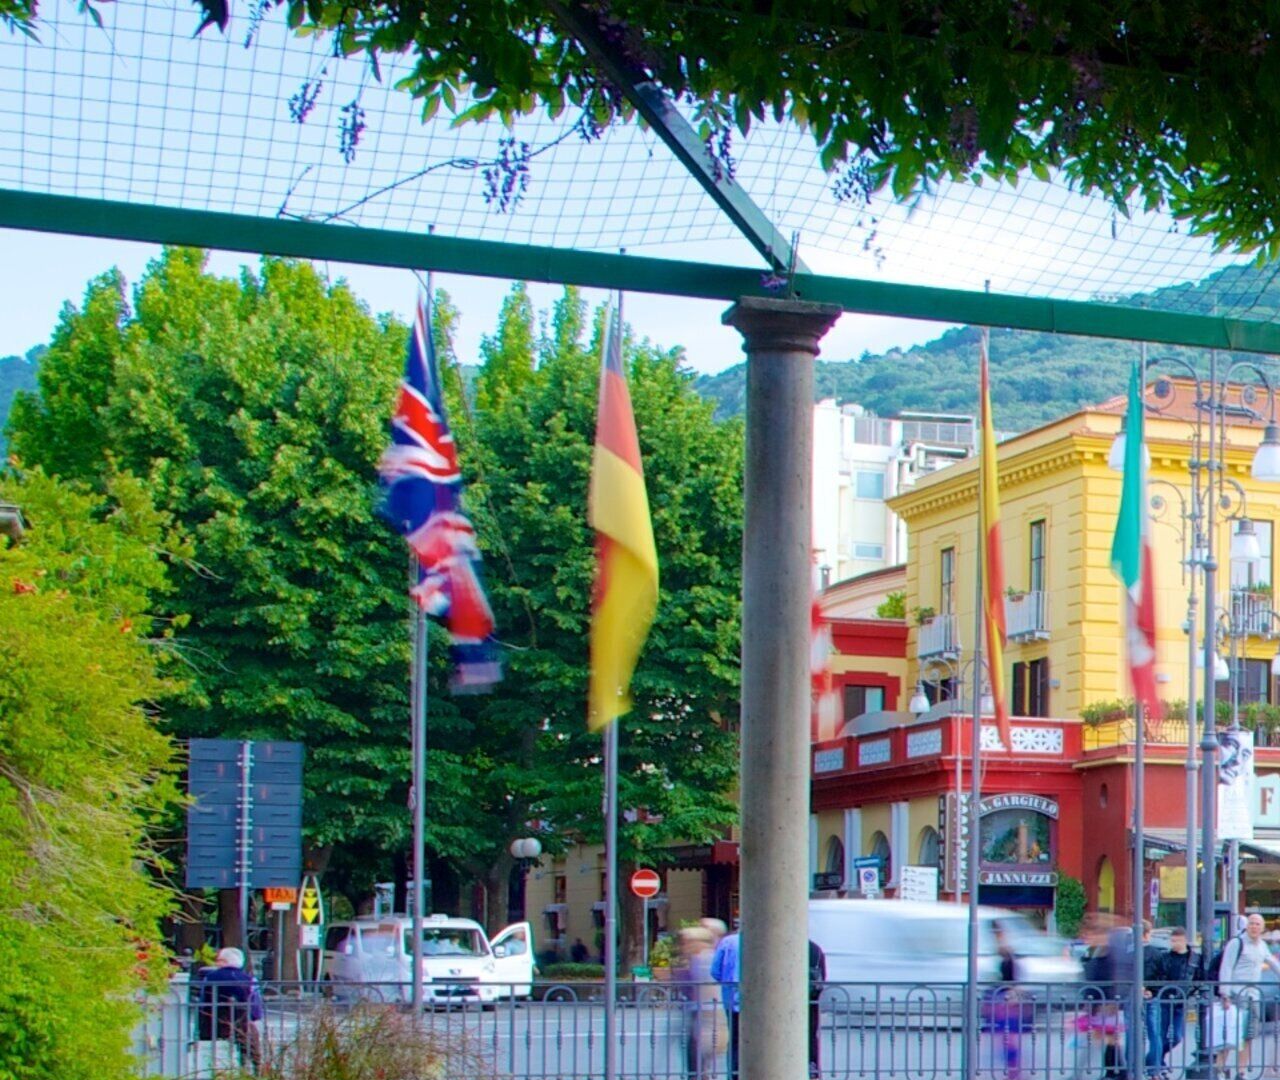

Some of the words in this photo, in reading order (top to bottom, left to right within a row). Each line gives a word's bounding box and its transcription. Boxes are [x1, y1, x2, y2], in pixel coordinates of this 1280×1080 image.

[993, 795, 1058, 815] GARGIULO
[986, 873, 1051, 885] JANNUZZI
[269, 887, 295, 900] TAXI
